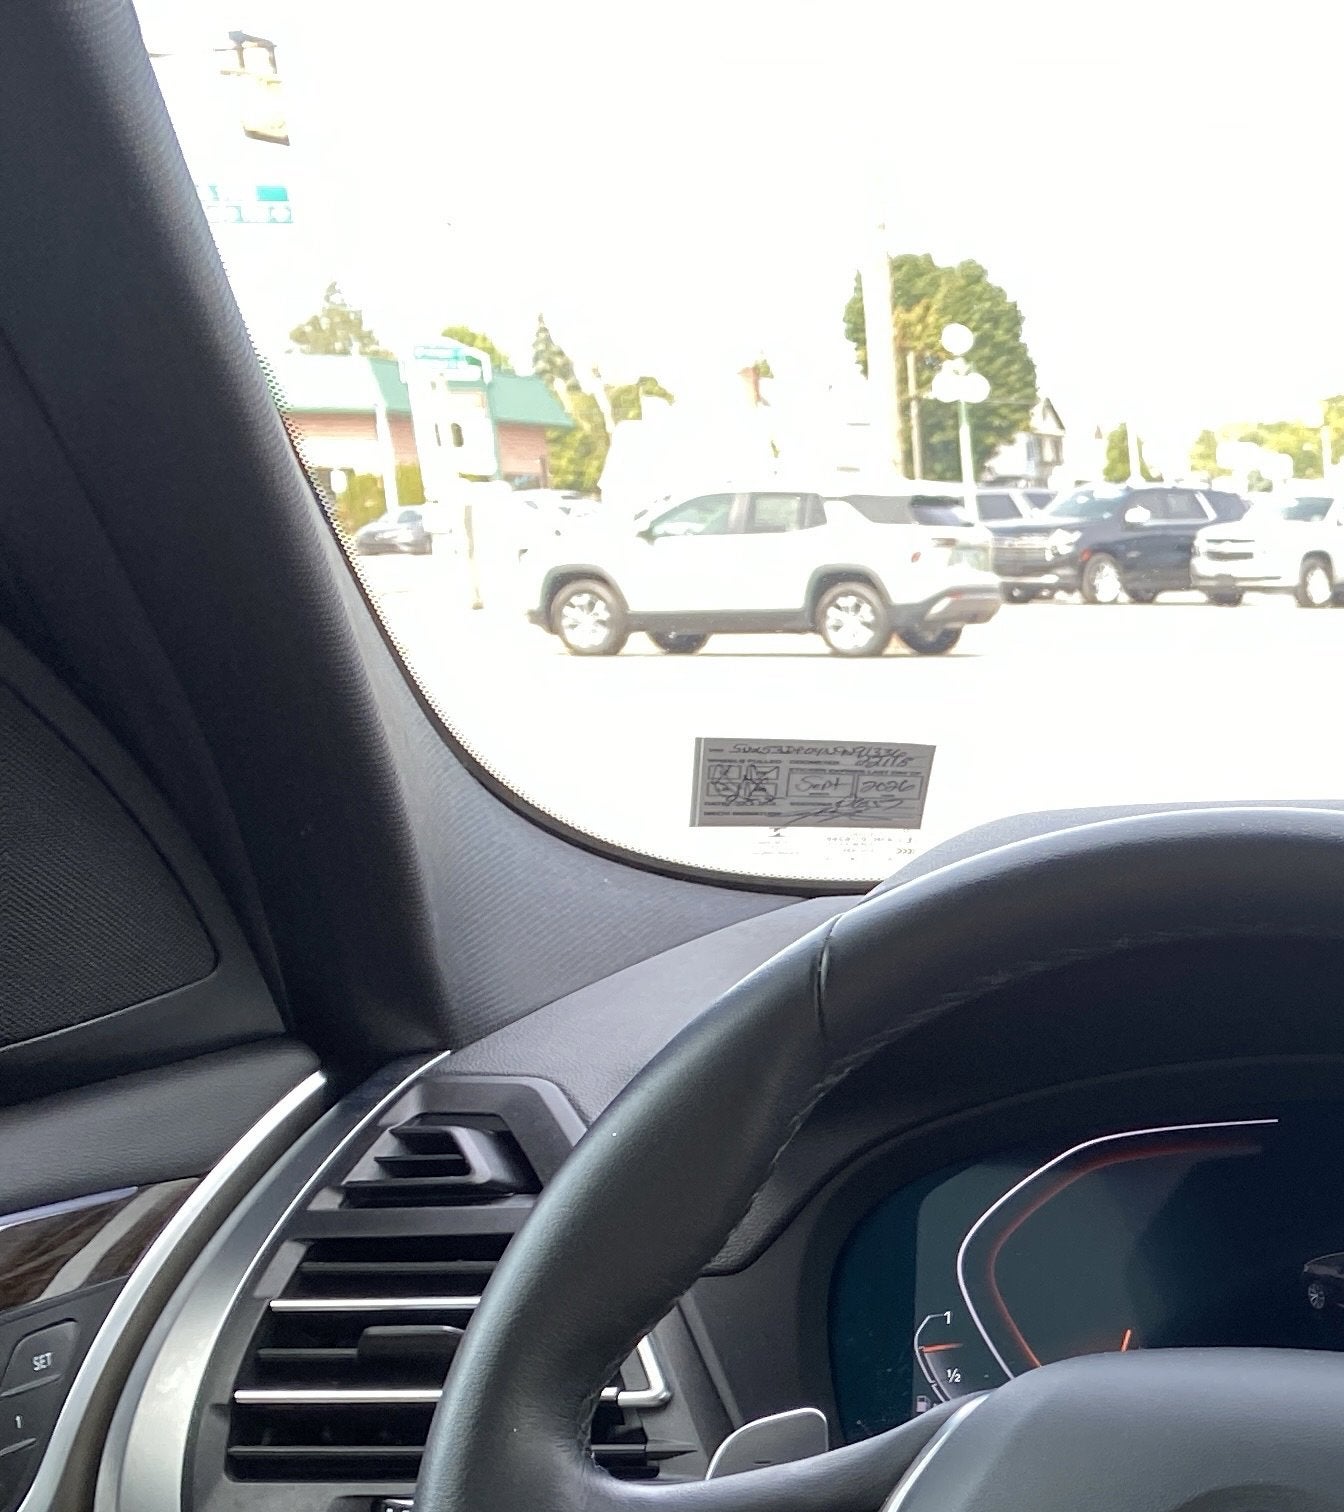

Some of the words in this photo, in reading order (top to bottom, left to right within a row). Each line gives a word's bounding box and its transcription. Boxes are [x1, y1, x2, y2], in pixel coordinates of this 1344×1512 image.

[861, 779, 915, 793] 2026
[32, 1351, 54, 1371] SET
[15, 1414, 22, 1429] 1
